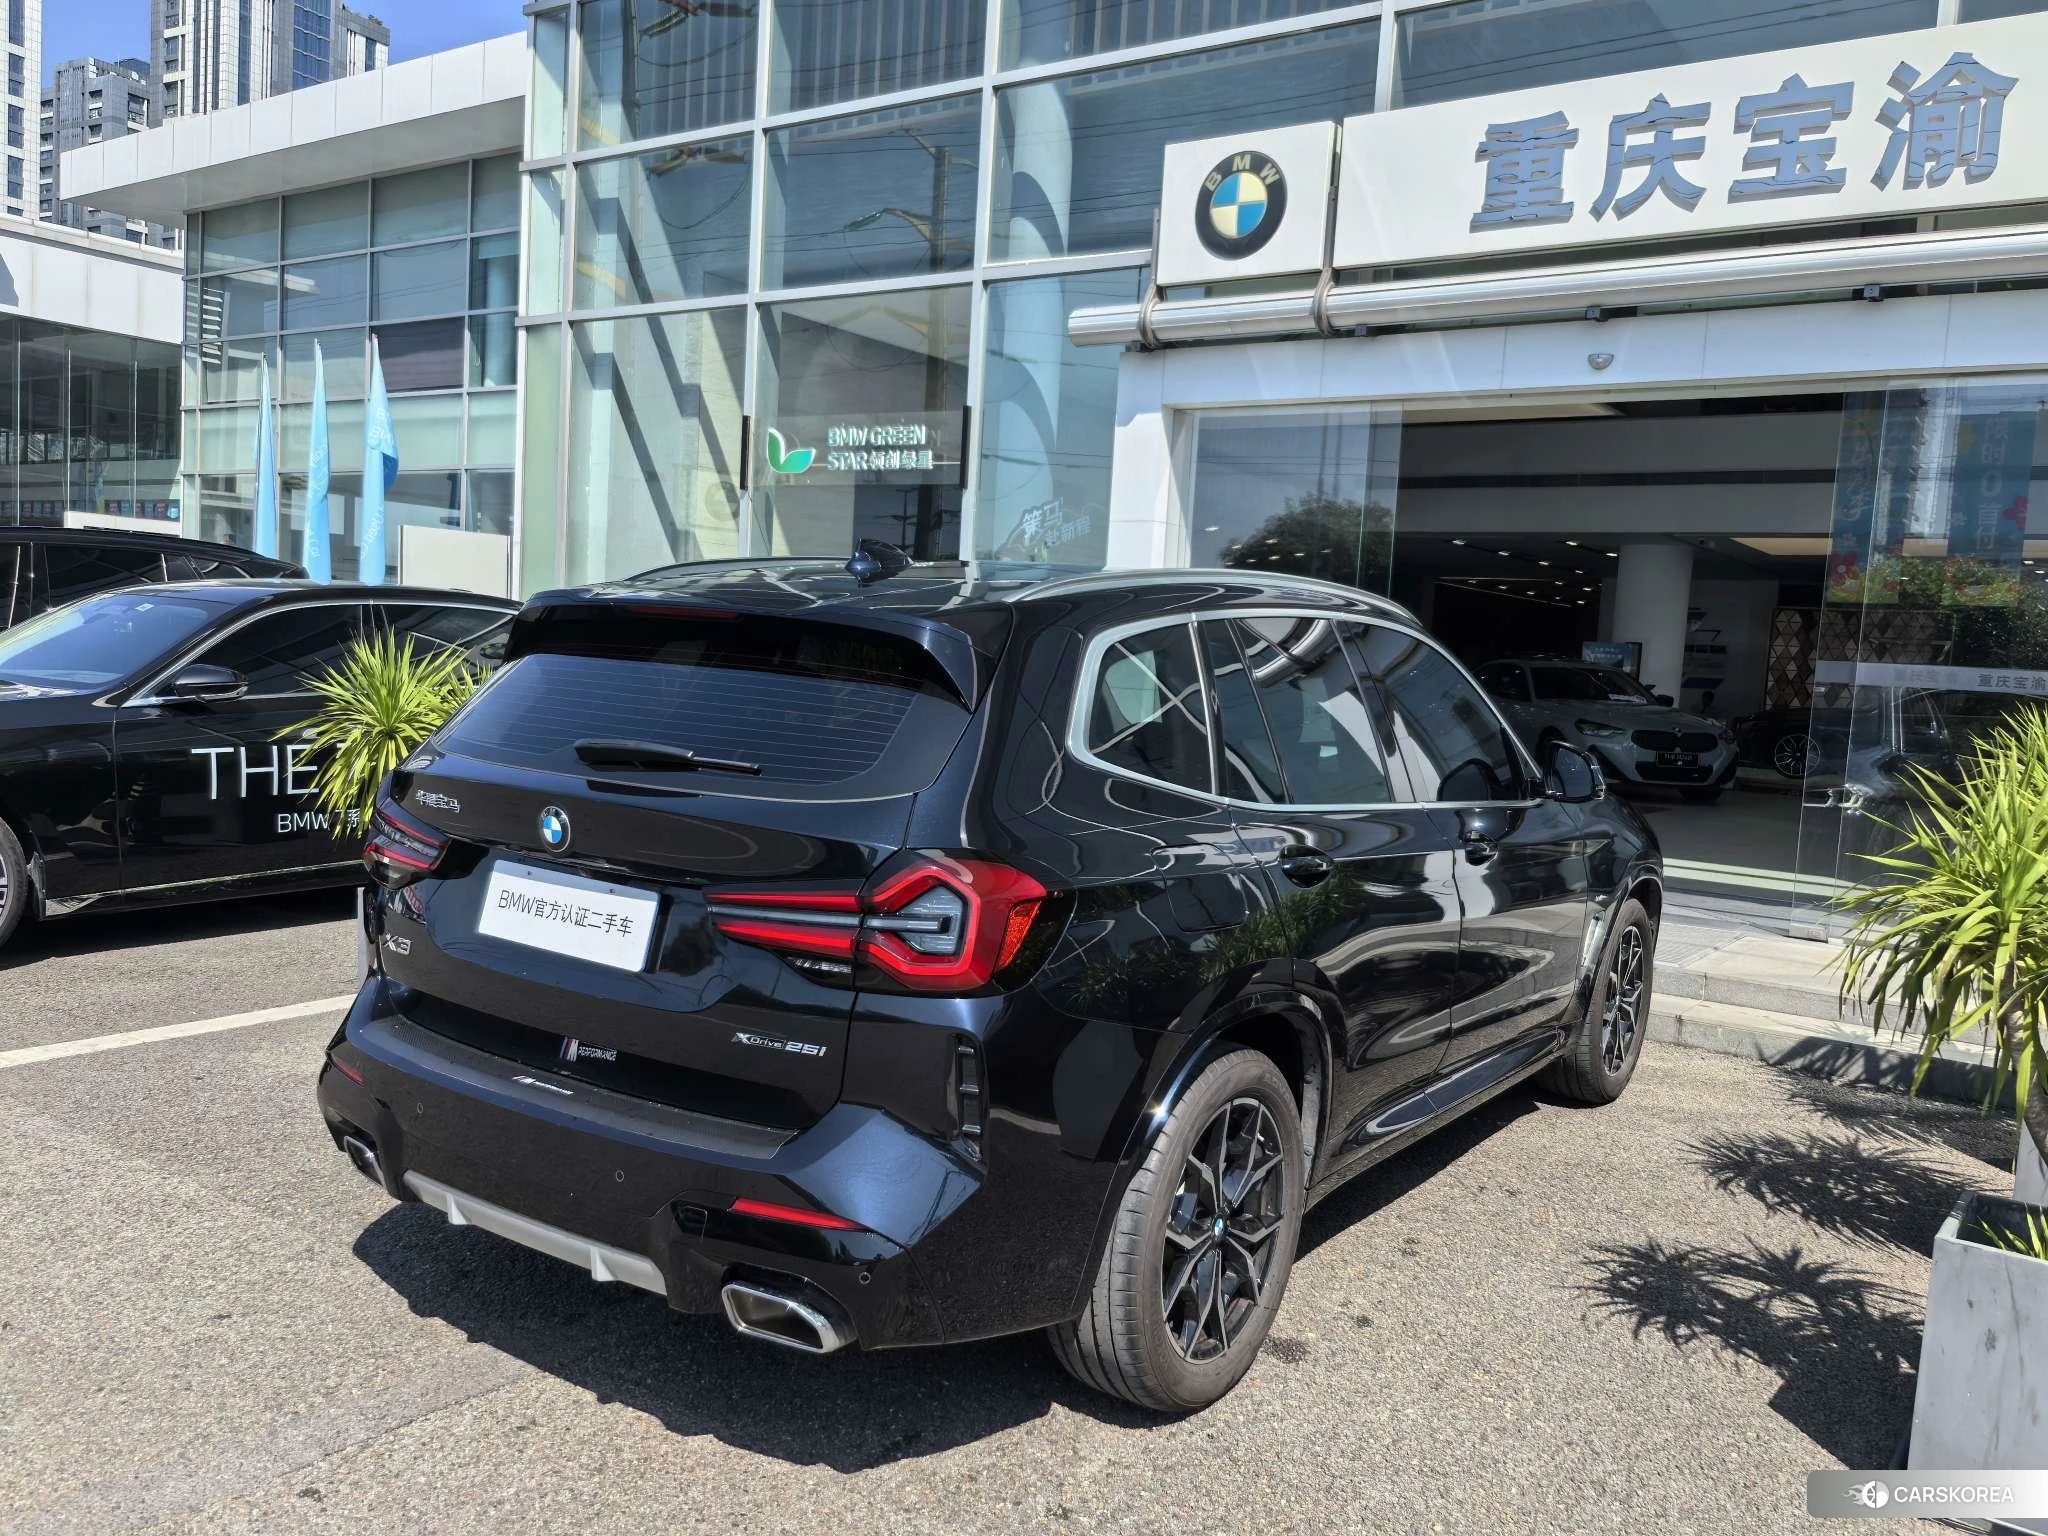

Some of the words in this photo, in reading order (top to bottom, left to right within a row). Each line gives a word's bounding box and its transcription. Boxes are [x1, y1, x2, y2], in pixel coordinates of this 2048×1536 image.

[1470, 52, 2019, 233] 重庆宝渝
[1203, 154, 1280, 192] BMW
[828, 425, 868, 447] BMW
[870, 424, 926, 446] GREEN
[828, 451, 868, 470] STAR
[1976, 672, 2046, 691] 重庆宝渝
[191, 744, 320, 800] THE
[277, 811, 329, 833] BMW
[498, 889, 634, 938] BMW官方认证二手车
[384, 933, 412, 956] X3
